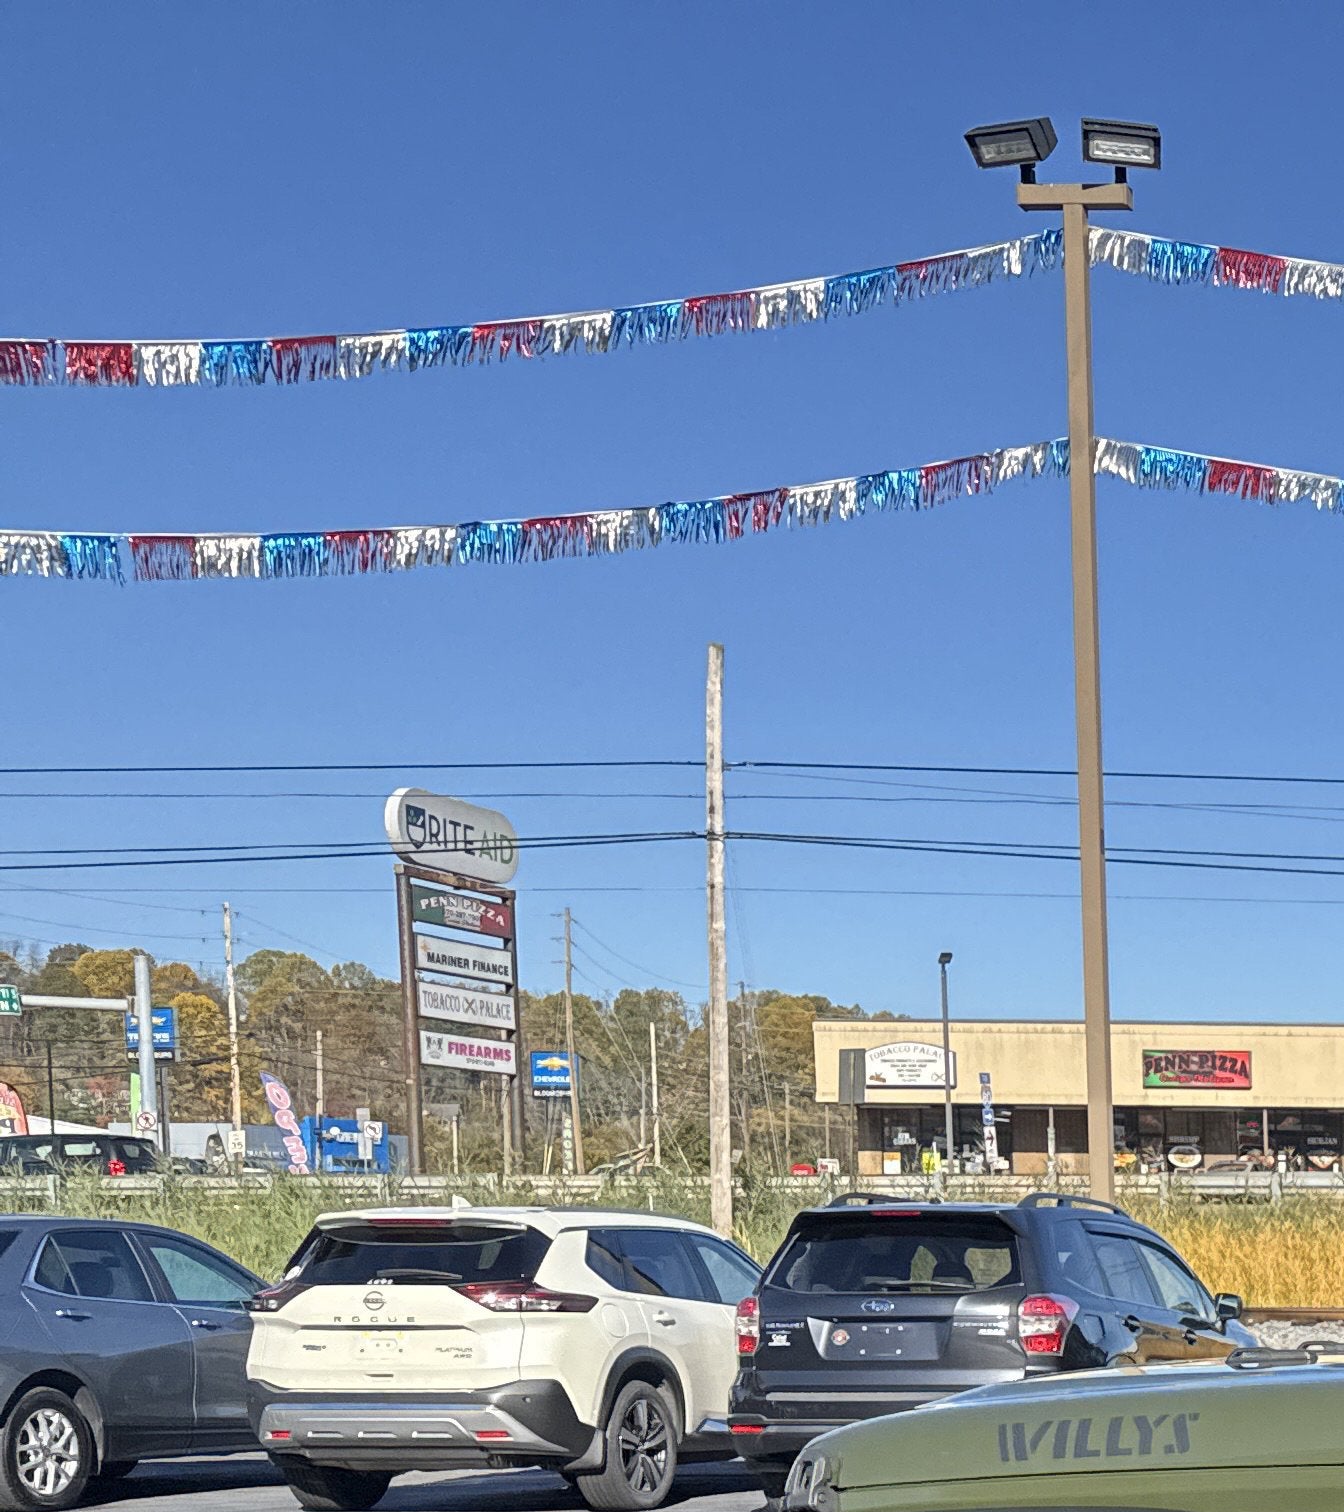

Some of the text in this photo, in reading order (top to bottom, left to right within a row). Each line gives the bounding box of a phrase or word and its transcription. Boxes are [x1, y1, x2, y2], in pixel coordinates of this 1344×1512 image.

[428, 813, 514, 865] RITE AID
[420, 896, 458, 909] PENN
[463, 898, 505, 926] PIZZA
[427, 951, 510, 976] MARINER FINANCE
[422, 990, 511, 1020] TOBACCO PALACE
[447, 1041, 512, 1062] FIREARMS
[869, 1046, 911, 1061] TOBACCO
[998, 1412, 1200, 1462] WILLYS
